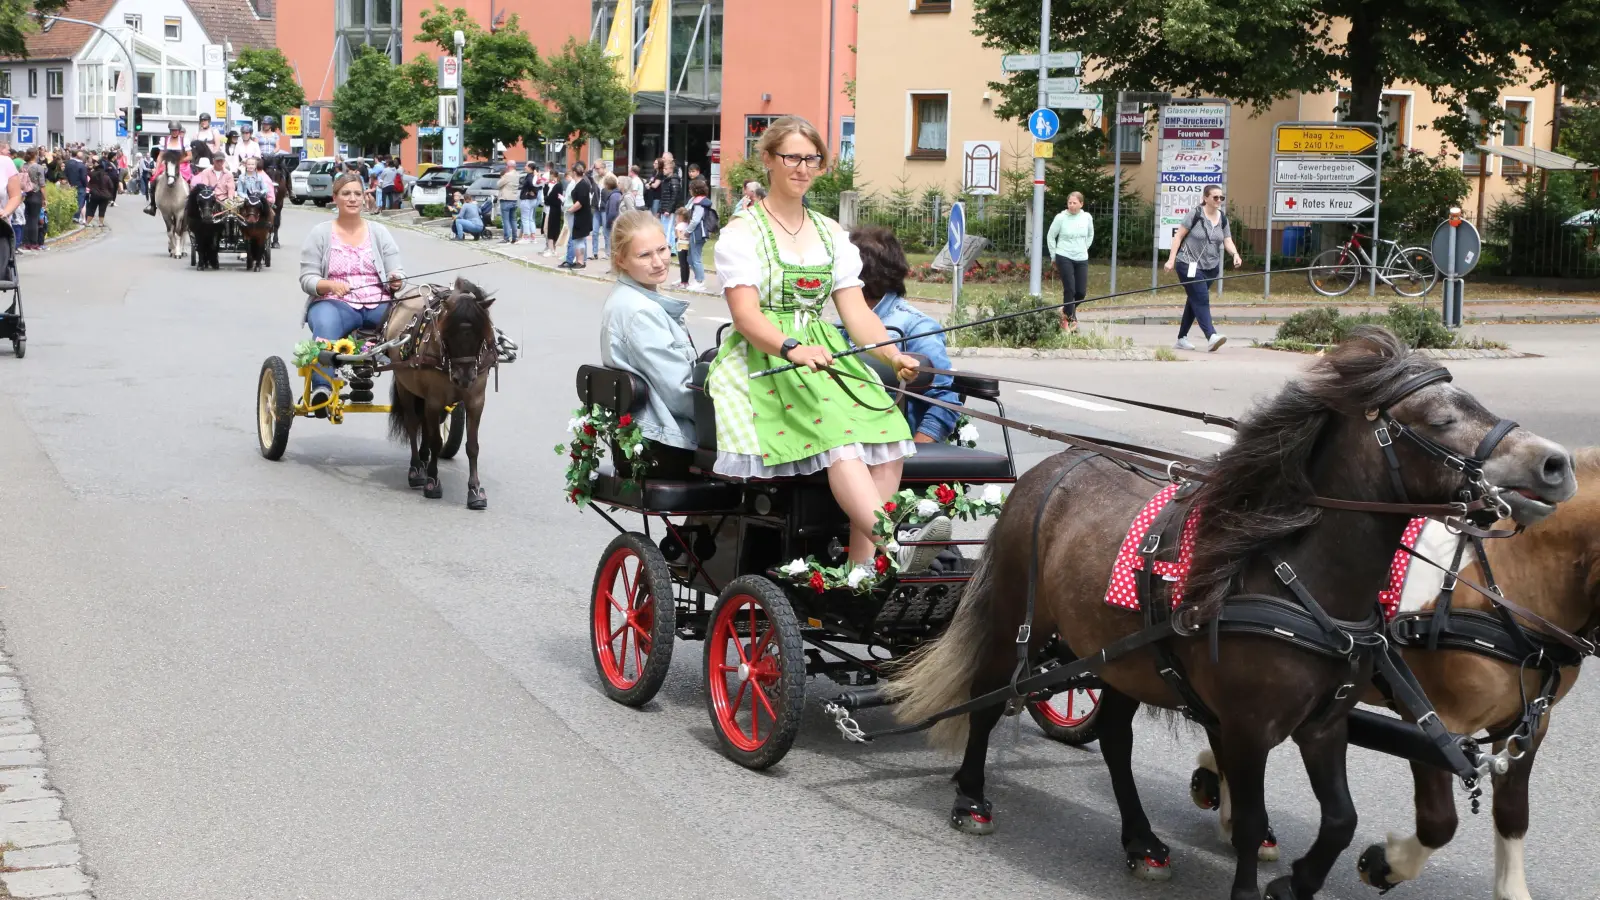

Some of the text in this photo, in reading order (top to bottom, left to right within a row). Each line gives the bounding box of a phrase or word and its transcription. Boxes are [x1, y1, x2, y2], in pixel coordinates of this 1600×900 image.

[1199, 107, 1224, 115] Heyde
[20, 129, 30, 142] P
[1177, 130, 1211, 138] Feuerwehr
[1303, 132, 1322, 140] Haag
[1297, 163, 1355, 172] Gewerbegebiet
[1162, 174, 1221, 182] Kfz-Tolksdorf
[1168, 185, 1202, 193] BOAS
[1302, 198, 1353, 209] Rotes Kreuz
